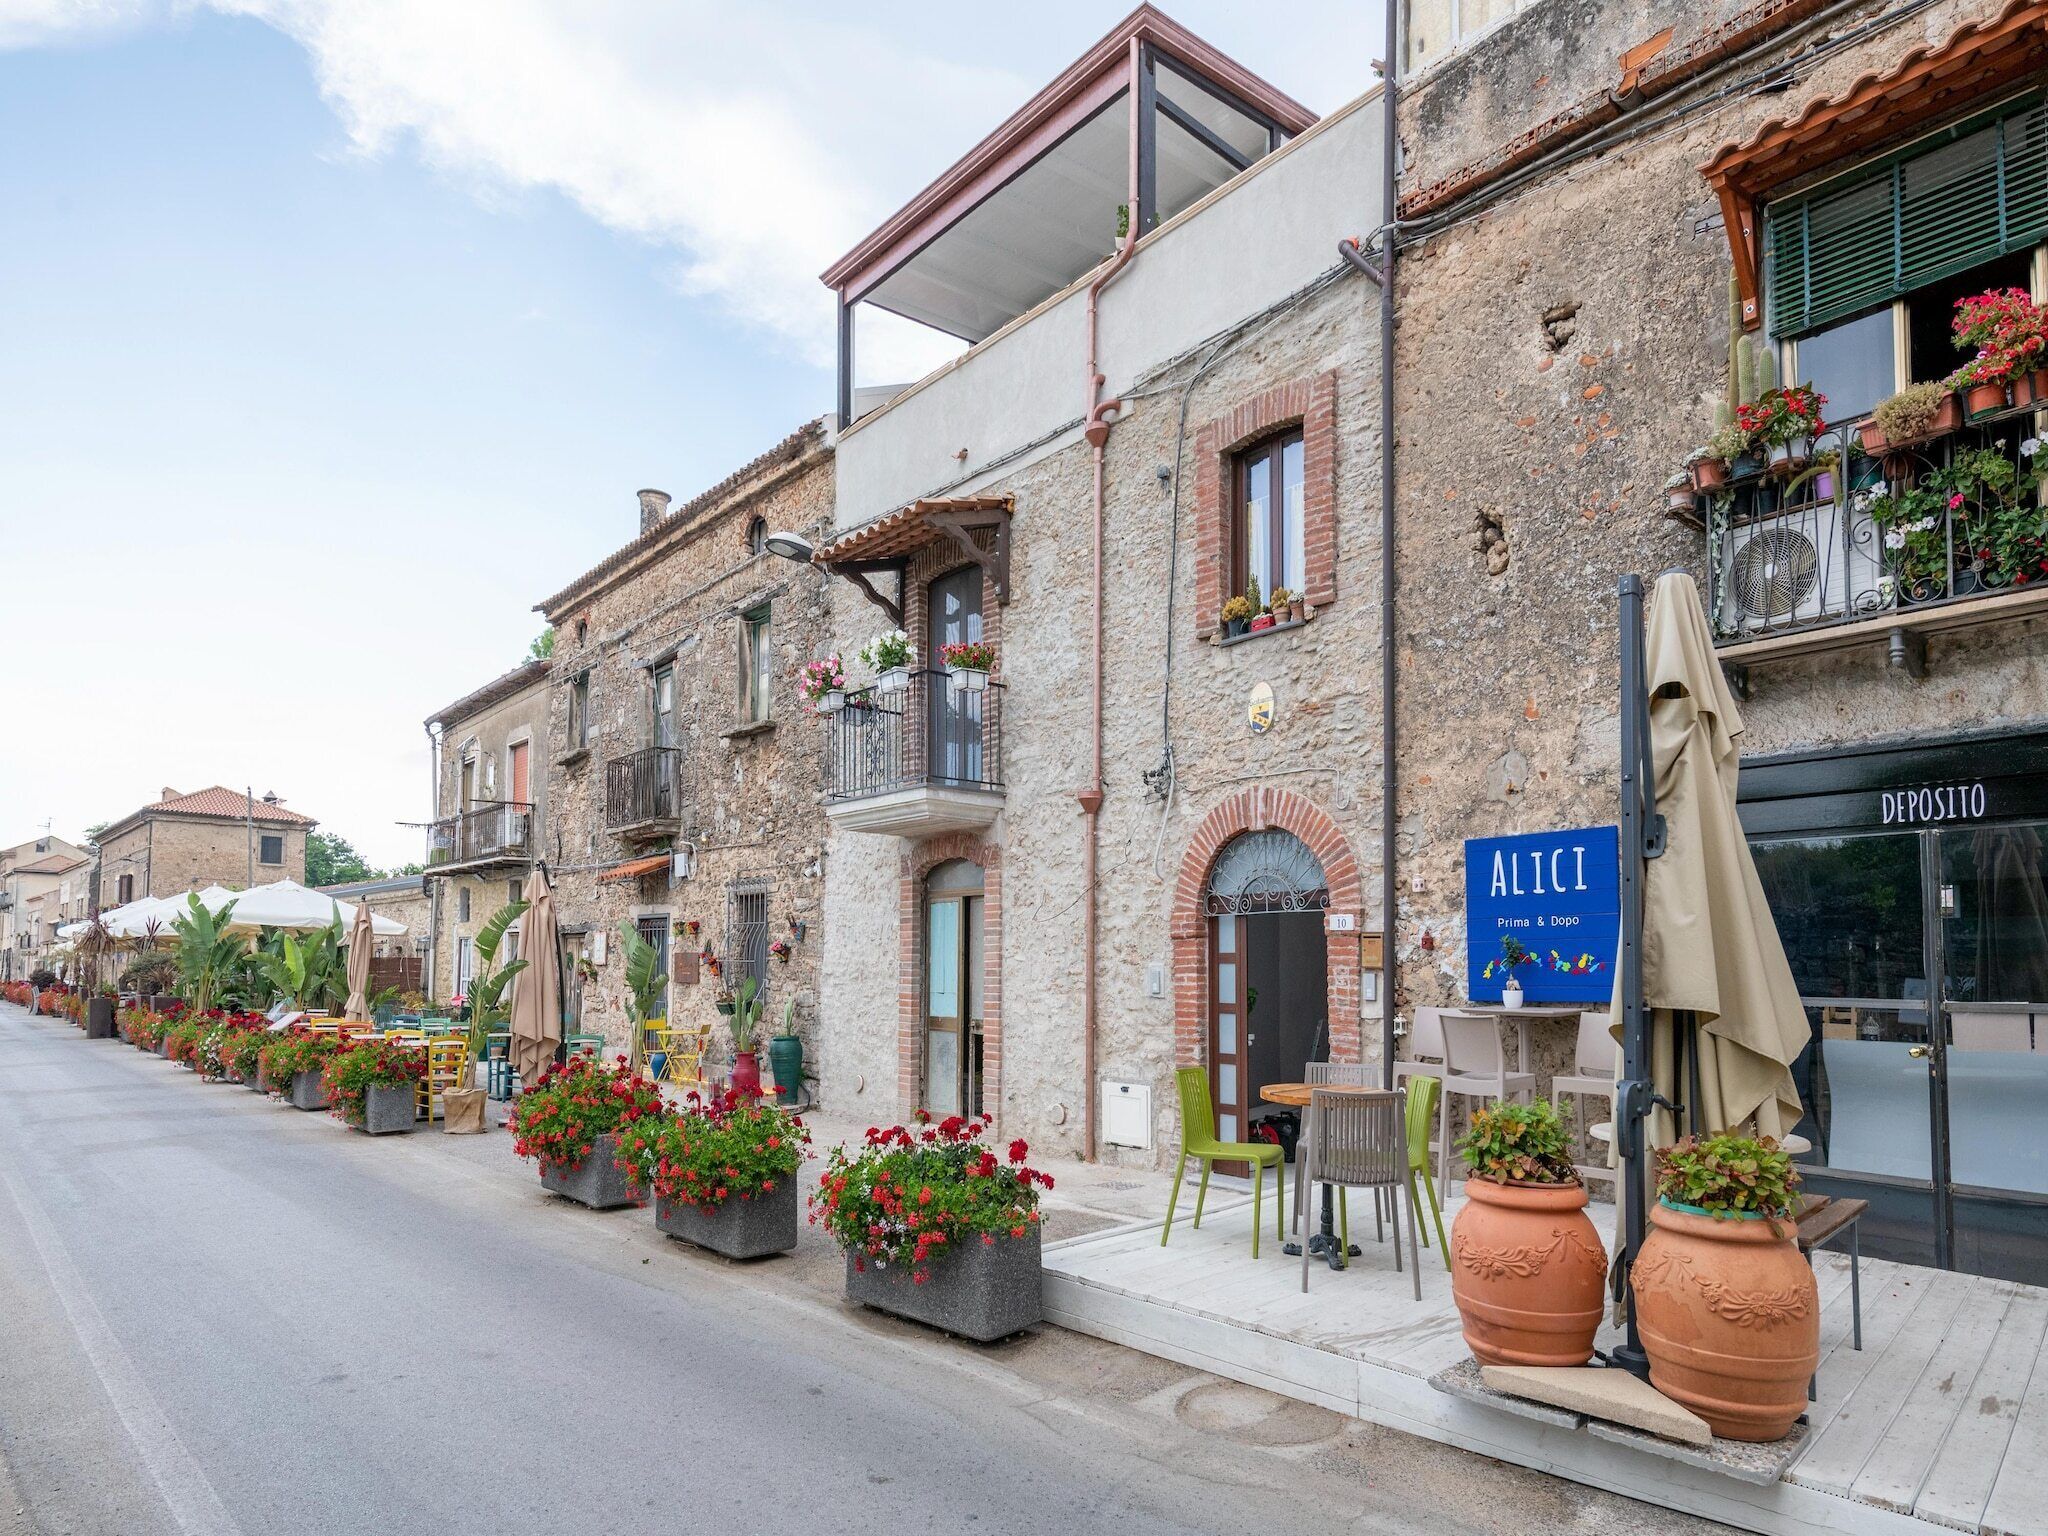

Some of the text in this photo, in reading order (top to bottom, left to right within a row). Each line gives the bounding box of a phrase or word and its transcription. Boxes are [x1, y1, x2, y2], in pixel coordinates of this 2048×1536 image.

[1881, 783, 1985, 824] DEPOSITO
[1490, 846, 1588, 897] ALICI
[1337, 918, 1347, 929] 10
[1497, 915, 1579, 928] Prima & Dopo
